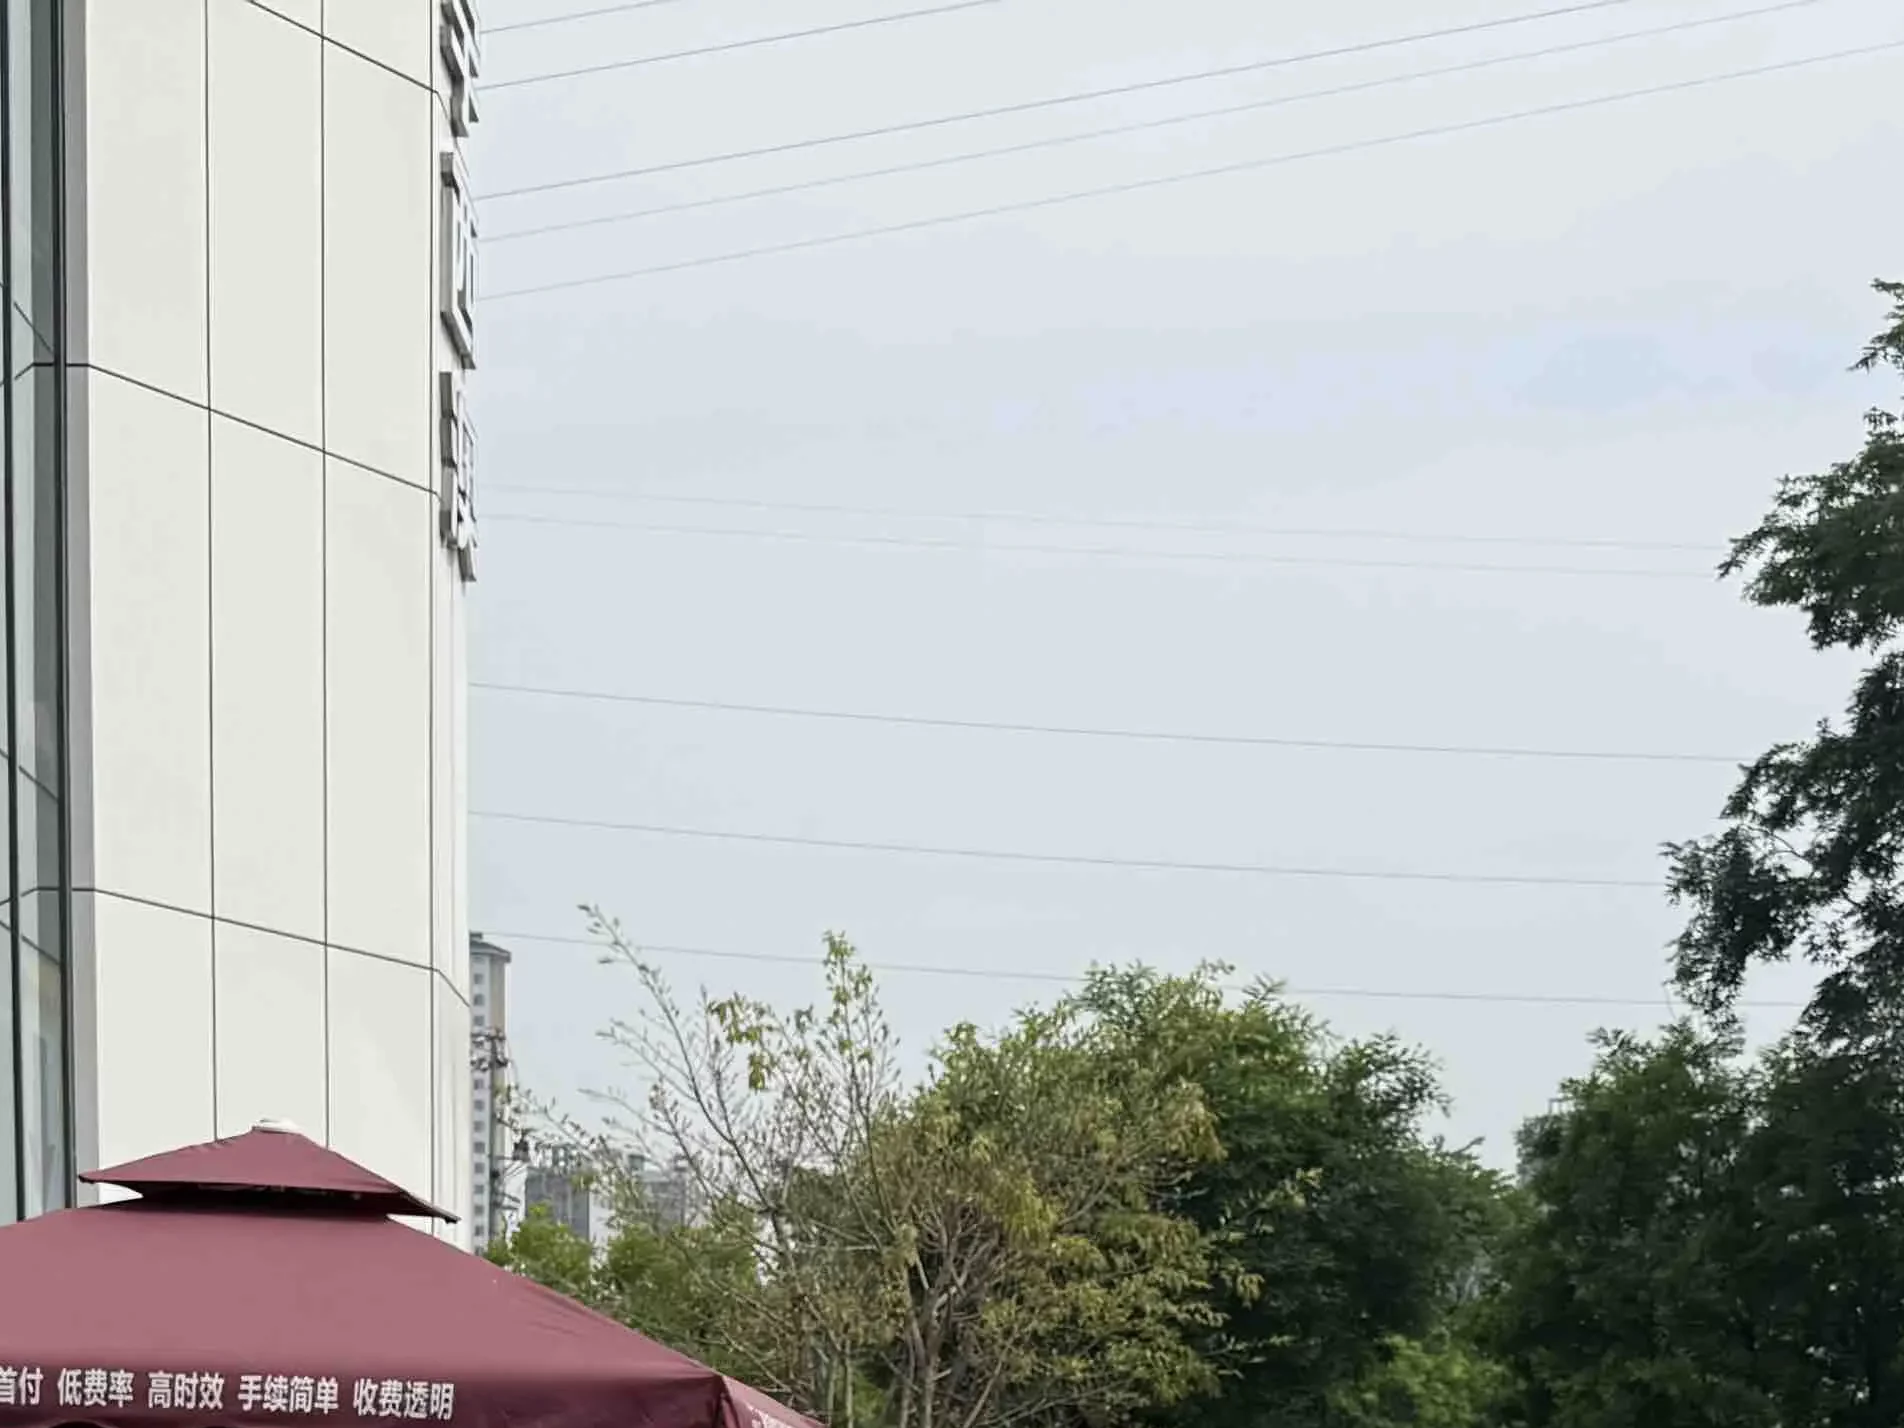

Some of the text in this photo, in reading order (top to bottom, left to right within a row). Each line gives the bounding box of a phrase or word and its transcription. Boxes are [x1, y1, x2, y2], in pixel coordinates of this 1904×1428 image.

[57, 1367, 135, 1408] 低费率
[148, 1370, 225, 1410] 高时效
[237, 1374, 339, 1414] 手续简单
[353, 1378, 455, 1420] 收费透明
